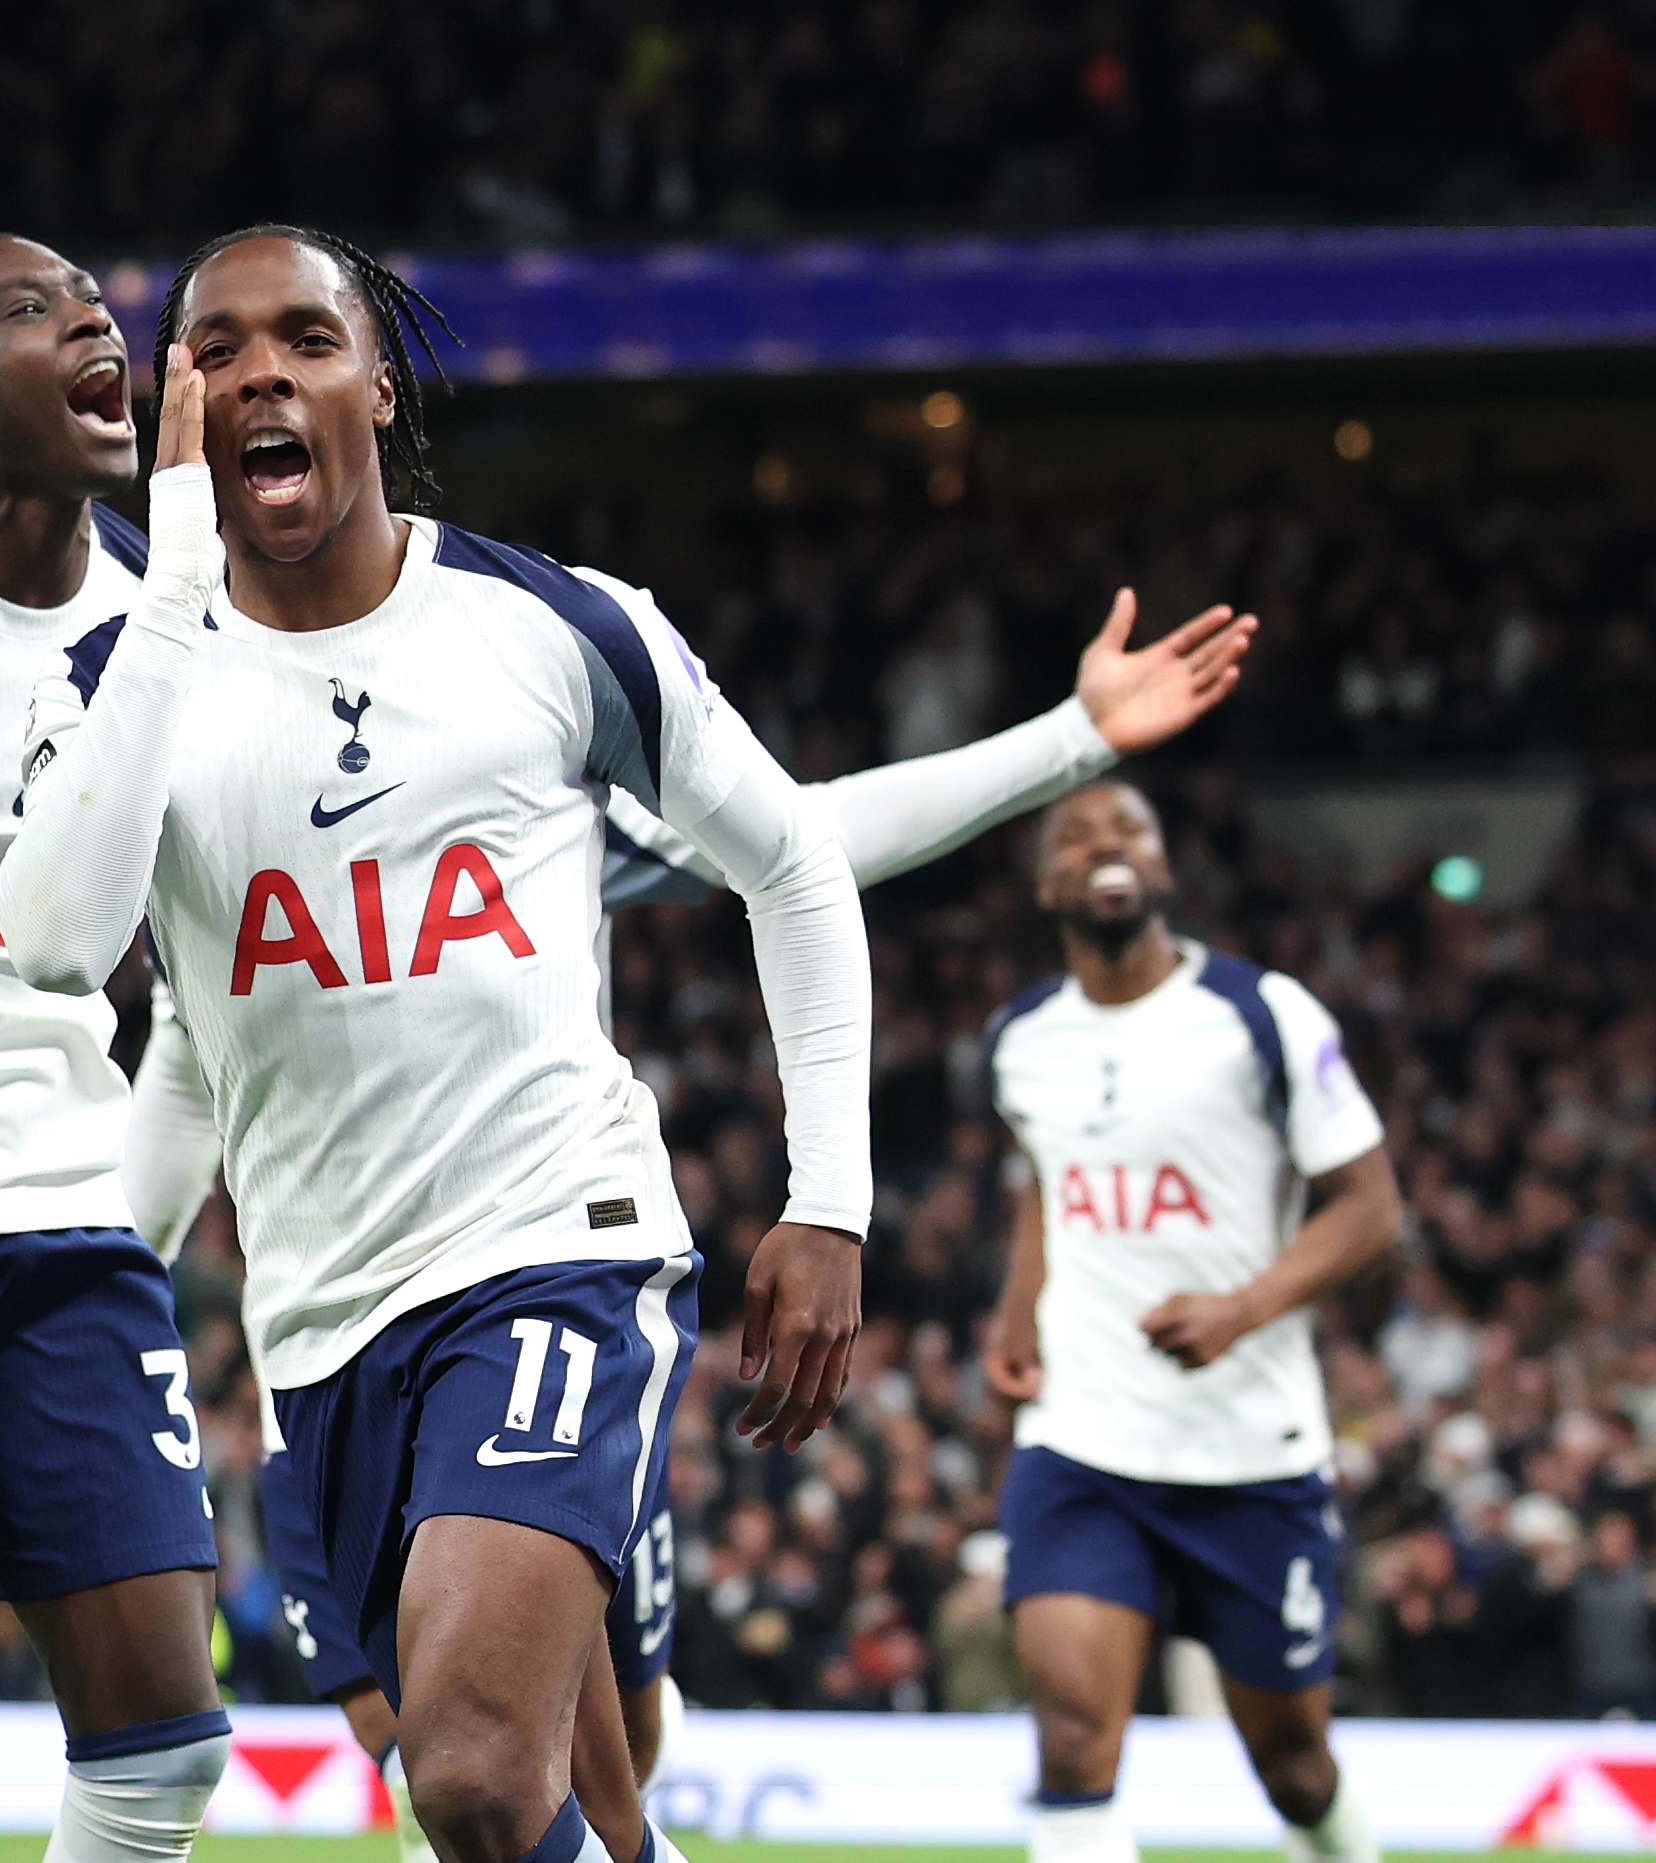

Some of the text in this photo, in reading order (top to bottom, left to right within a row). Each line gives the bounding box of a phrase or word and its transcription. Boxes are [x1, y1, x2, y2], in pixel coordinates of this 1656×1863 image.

[229, 843, 538, 997] AIA
[1060, 1163, 1214, 1235] AIA
[504, 1318, 598, 1446] 11
[632, 1509, 674, 1624] 13
[1281, 1556, 1325, 1634] 4
